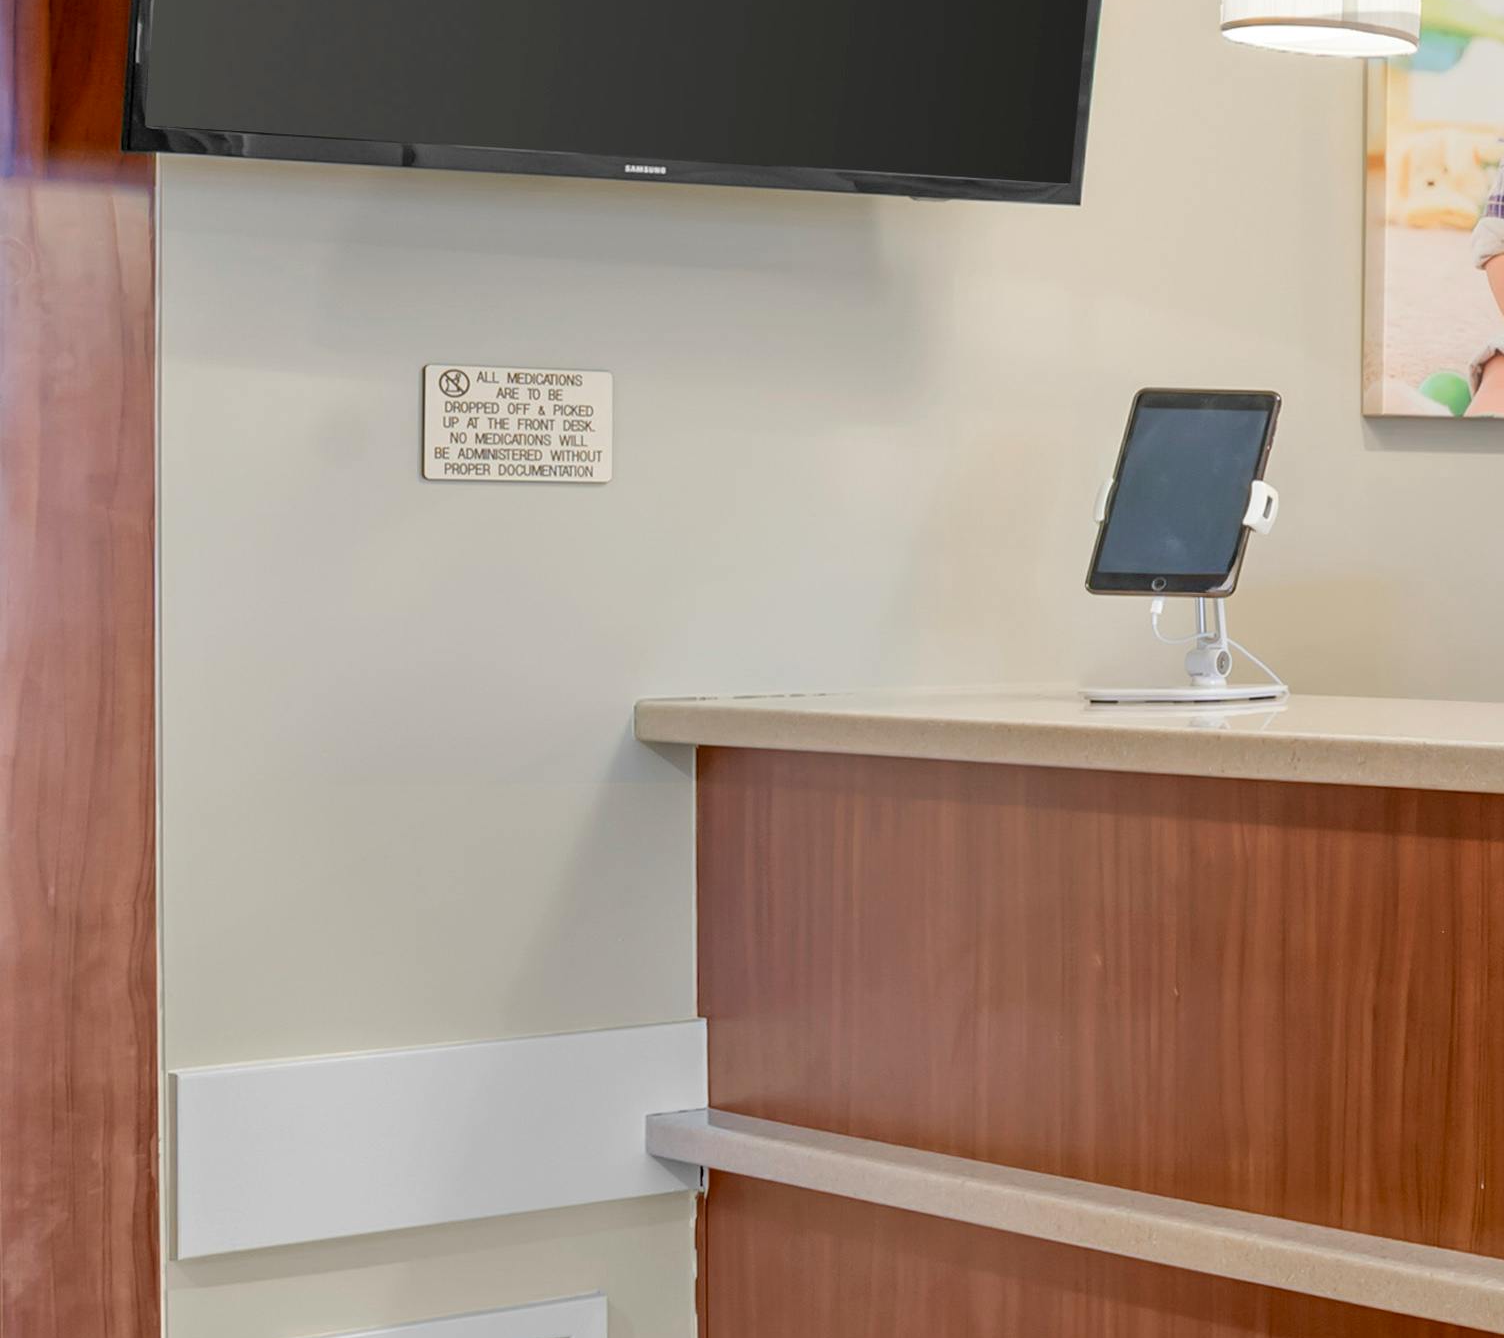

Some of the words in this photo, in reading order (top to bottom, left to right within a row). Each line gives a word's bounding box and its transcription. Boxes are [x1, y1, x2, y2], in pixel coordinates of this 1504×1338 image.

[625, 164, 667, 175] SAMSUNG
[476, 371, 499, 384] ALL
[507, 373, 583, 386] MEDICATIONS
[496, 387, 519, 400] ARE
[527, 388, 541, 400] TO
[548, 389, 563, 401] BE
[445, 401, 500, 414] DROPPED
[507, 403, 531, 415] OFF
[538, 405, 545, 416] &
[553, 404, 594, 417] PICKED
[443, 416, 459, 429] UP
[467, 417, 480, 429] AT
[488, 418, 510, 430] THE
[517, 419, 555, 431] FRONT
[563, 420, 596, 432] DESK.
[450, 432, 467, 444] NO
[475, 433, 551, 446] MEDICATIONS
[559, 435, 588, 447] WILL
[434, 447, 450, 460] BE
[457, 447, 543, 461] ADMINISTERED
[550, 450, 603, 462] WITHOUT
[444, 463, 491, 476] PROPER
[498, 464, 594, 477] DOCUMENTATION
